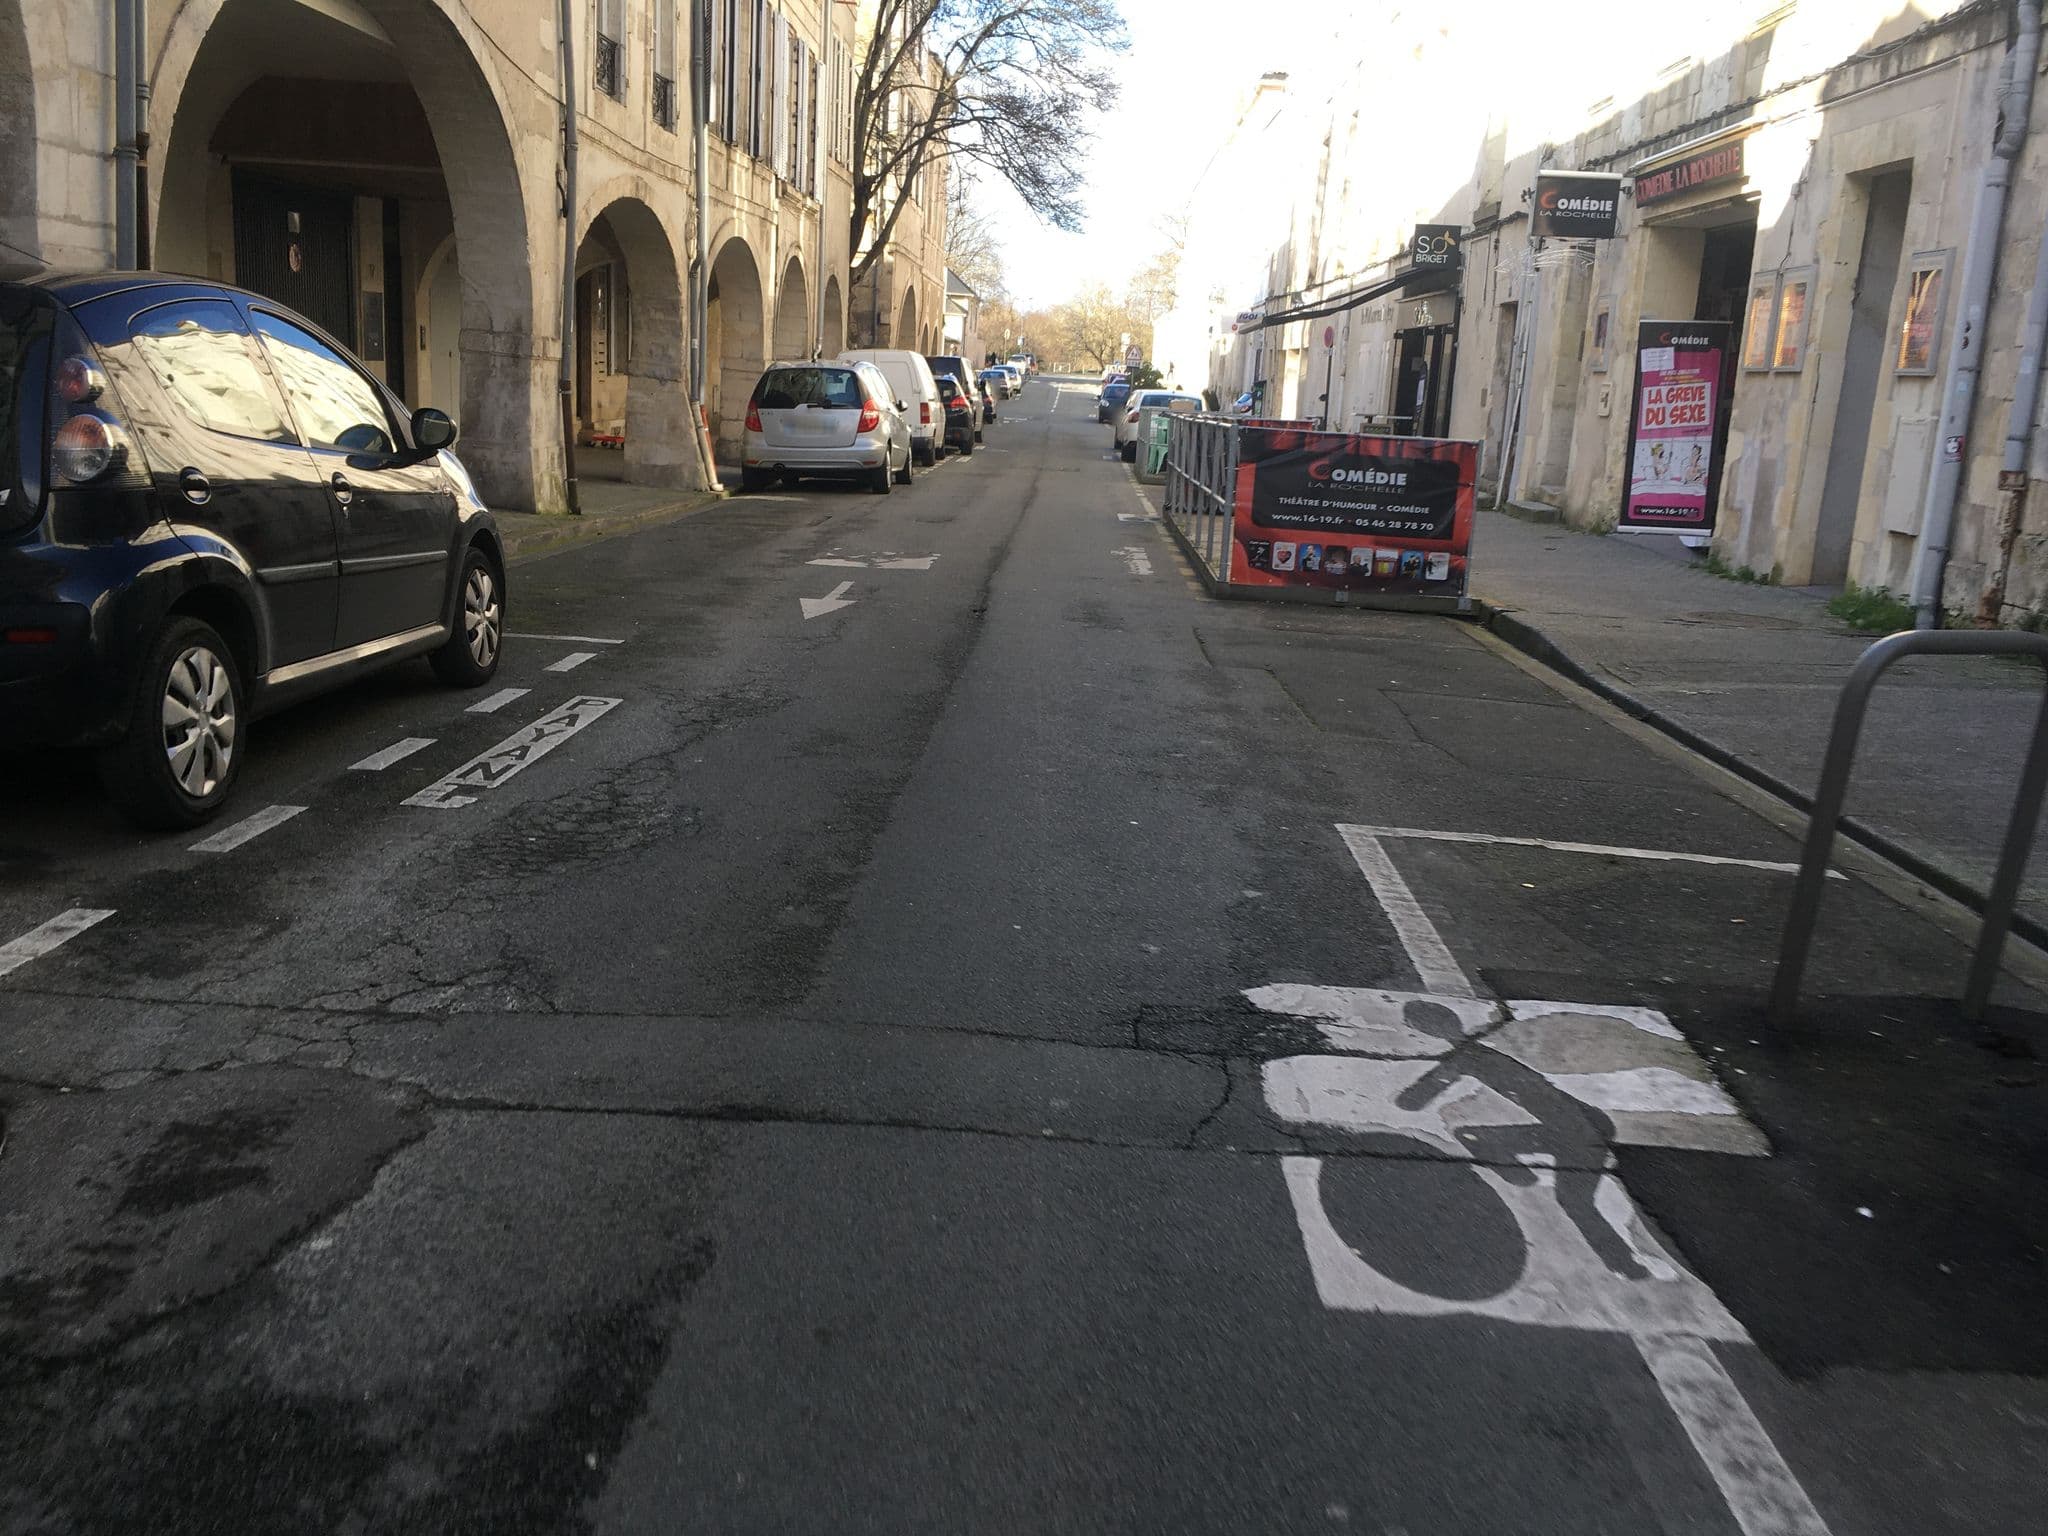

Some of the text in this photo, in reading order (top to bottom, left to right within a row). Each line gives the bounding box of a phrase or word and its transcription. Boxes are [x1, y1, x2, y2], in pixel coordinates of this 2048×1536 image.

[1676, 164, 1690, 189] LA
[1690, 147, 1741, 185] ROCHELLE
[1539, 190, 1613, 211] COMÉDIE
[1556, 211, 1612, 219] ROCHELLE
[1416, 236, 1448, 254] SO
[1415, 253, 1449, 264] BRIGET
[1659, 332, 1709, 345] COMÉDIE
[1648, 388, 1663, 405] LA
[1645, 404, 1706, 426] DU SEXE
[1308, 460, 1408, 486] COMÉDIE
[1330, 482, 1406, 495] ROCHELLE
[1279, 497, 1319, 507] THÉÂTRE
[1322, 500, 1377, 511] D'HUMOUR
[1386, 504, 1430, 514] COMÉDIE
[1272, 513, 1345, 525] www.16-19.fr
[1355, 518, 1369, 527] 05
[1371, 519, 1386, 528] 46
[1388, 520, 1402, 529] 28
[1404, 521, 1418, 530] 78
[1420, 522, 1434, 531] 70
[433, 698, 611, 803] PAYANT
